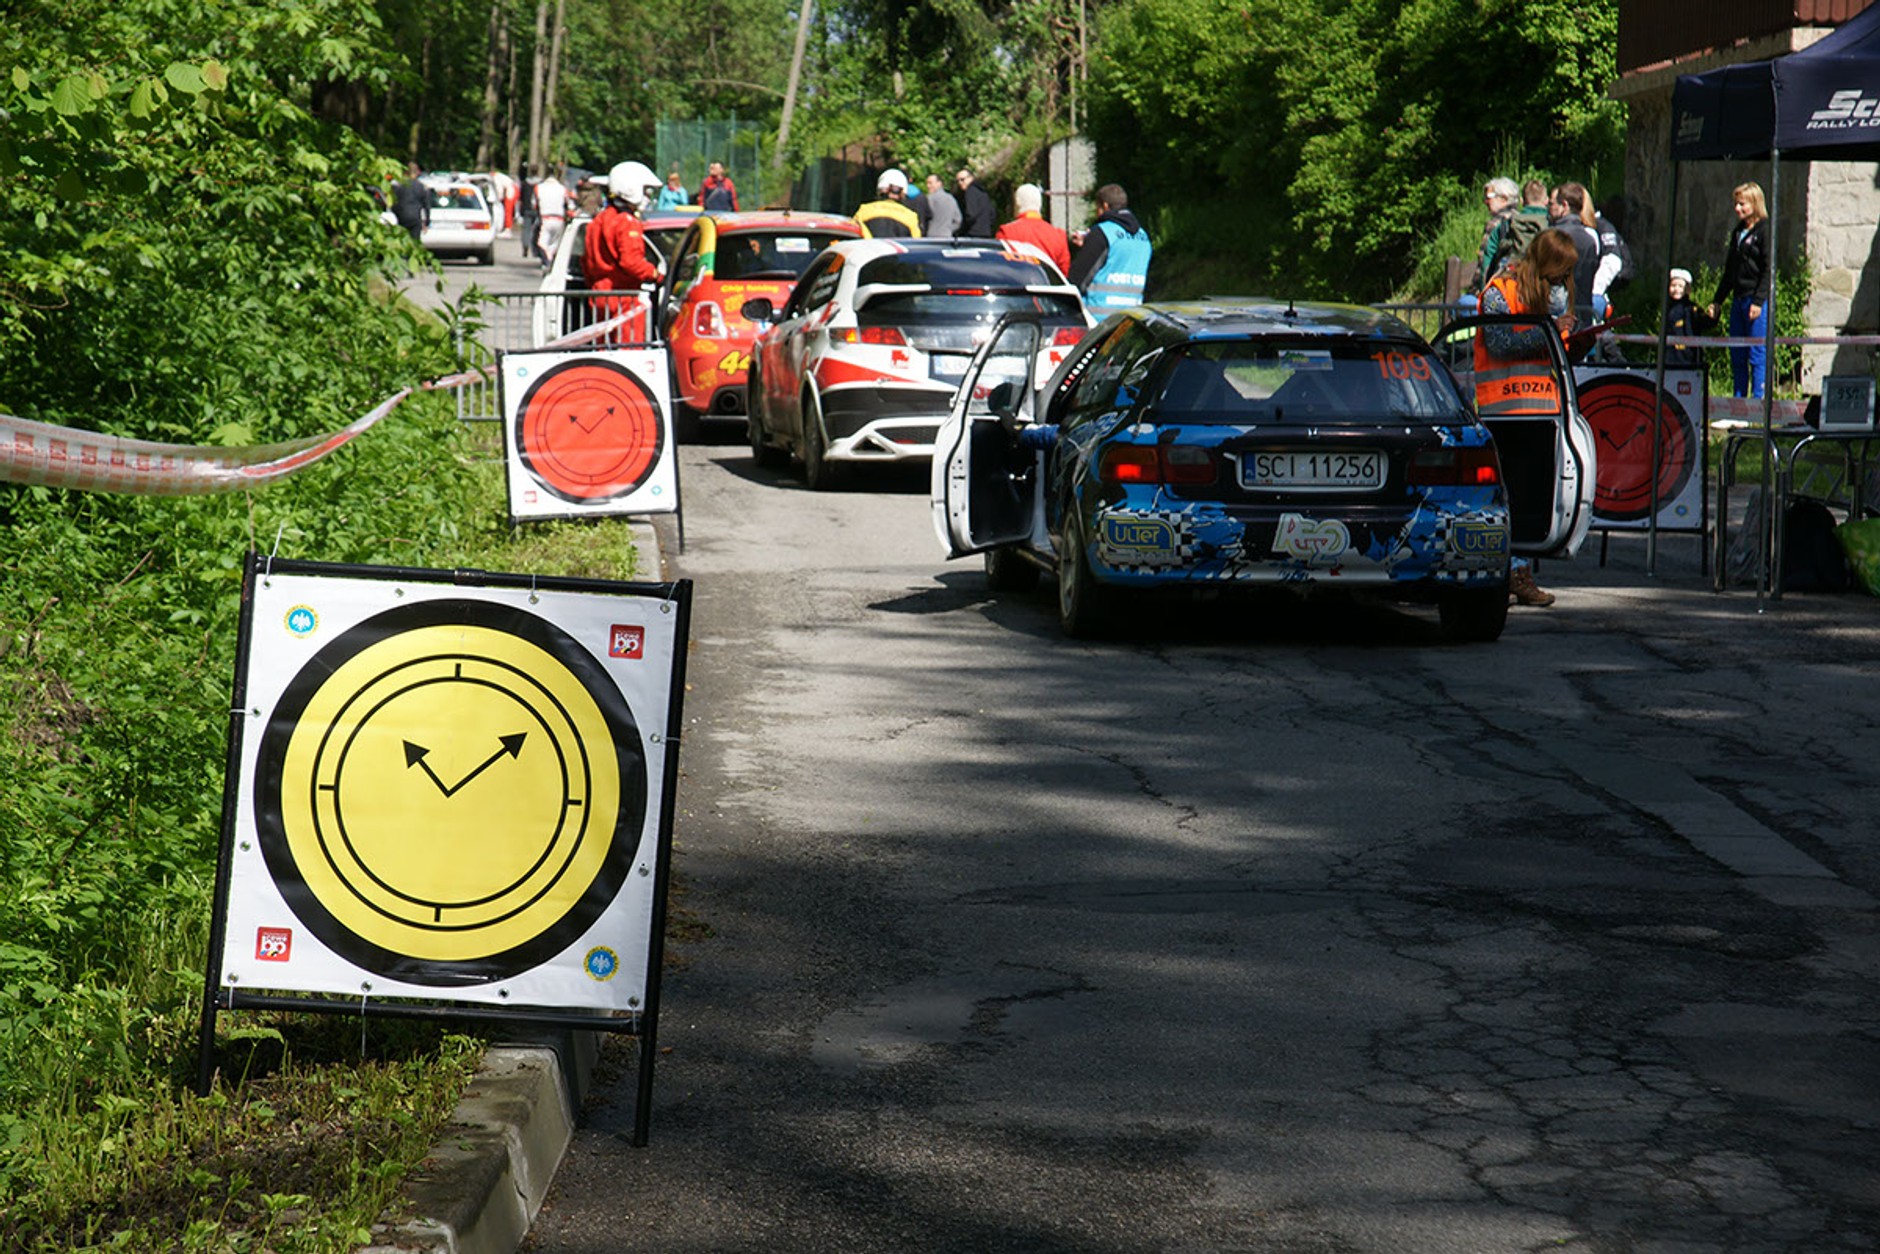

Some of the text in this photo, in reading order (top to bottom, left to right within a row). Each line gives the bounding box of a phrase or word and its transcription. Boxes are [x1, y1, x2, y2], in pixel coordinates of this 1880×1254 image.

[1806, 120, 1857, 130] RALLY
[1370, 351, 1431, 381] 109
[1502, 382, 1552, 396] SĘDZIA
[1257, 455, 1294, 478] SCI
[1309, 455, 1375, 478] 11256
